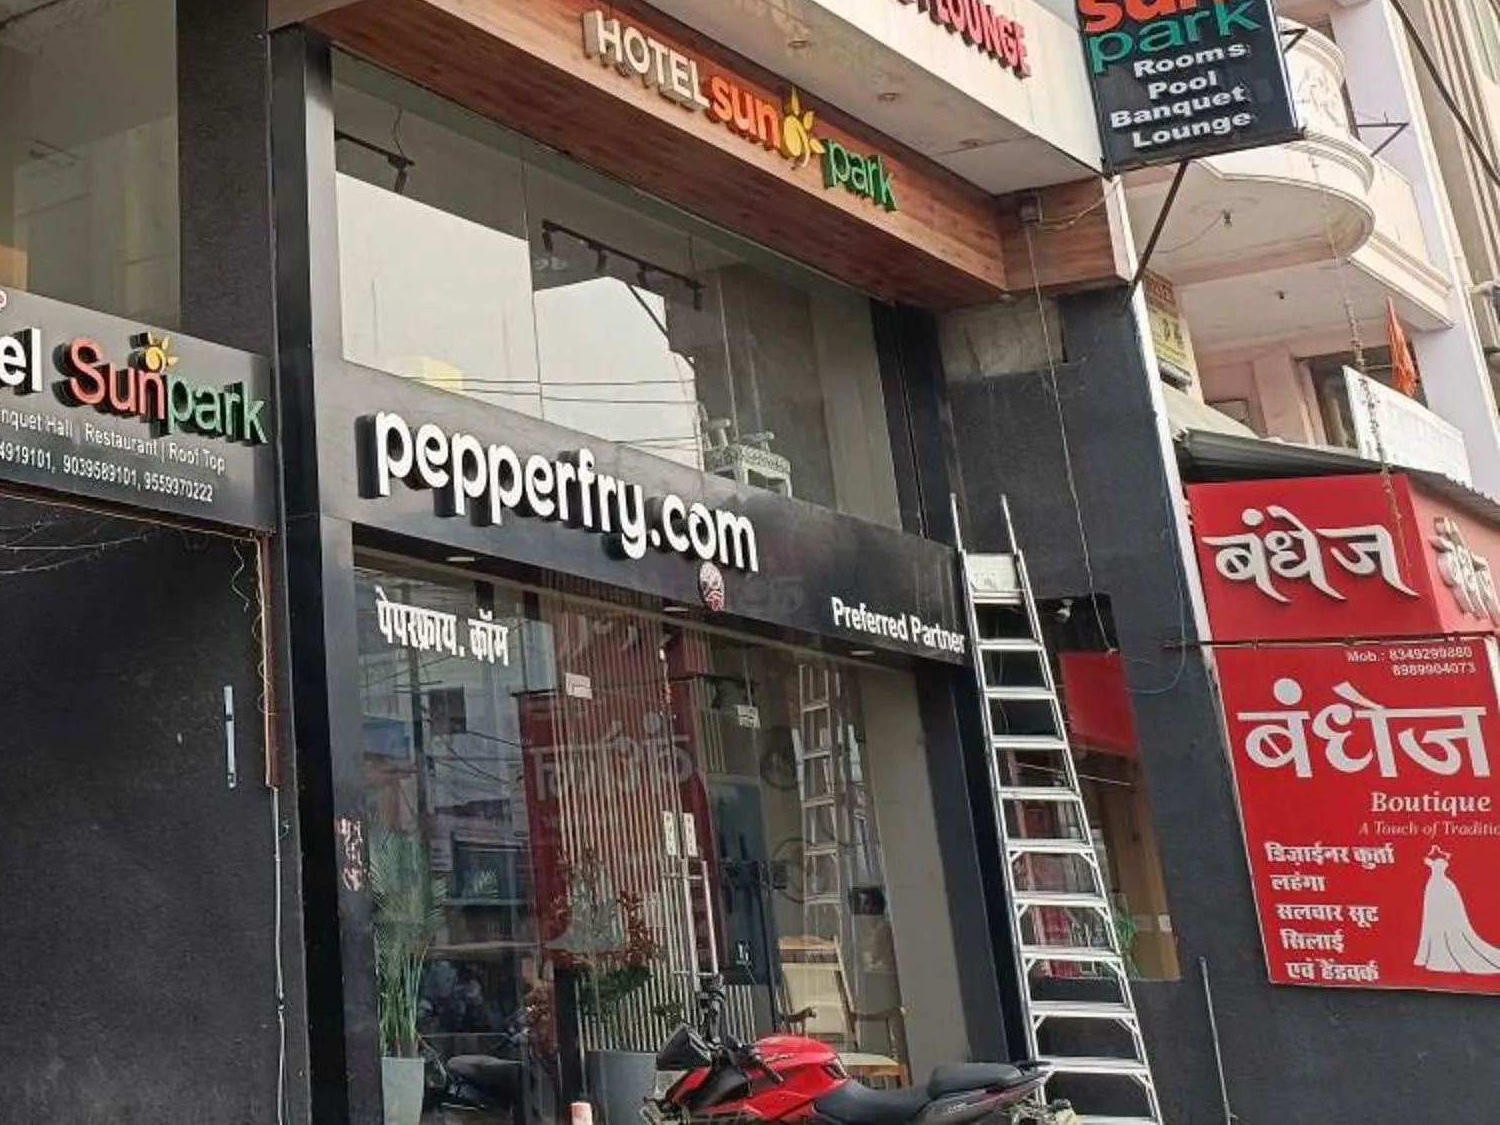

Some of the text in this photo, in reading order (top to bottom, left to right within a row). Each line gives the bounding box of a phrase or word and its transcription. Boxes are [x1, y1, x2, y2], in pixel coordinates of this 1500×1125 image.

[1087, 0, 1263, 72] park
[585, 10, 709, 108] HOTEL
[1133, 43, 1246, 78] Rooms
[1110, 85, 1247, 128] Banquet
[1148, 70, 1218, 100] Pool
[1132, 112, 1251, 148] Lounge
[45, 416, 73, 438] Hall
[85, 423, 157, 456] Restaurant
[169, 443, 200, 465] Roof
[202, 448, 225, 475] Top
[374, 410, 760, 573] pepperfry.com
[1201, 504, 1420, 604] बंधेज
[831, 596, 965, 654] Preferred Partner
[1238, 677, 1491, 779] बंधेज
[1371, 791, 1492, 817] Boutique
[1359, 823, 1369, 835] A
[1373, 821, 1419, 836] Touch
[1422, 822, 1438, 839] of
[1275, 904, 1344, 921] सलवार
[1280, 928, 1345, 954] सिलाई
